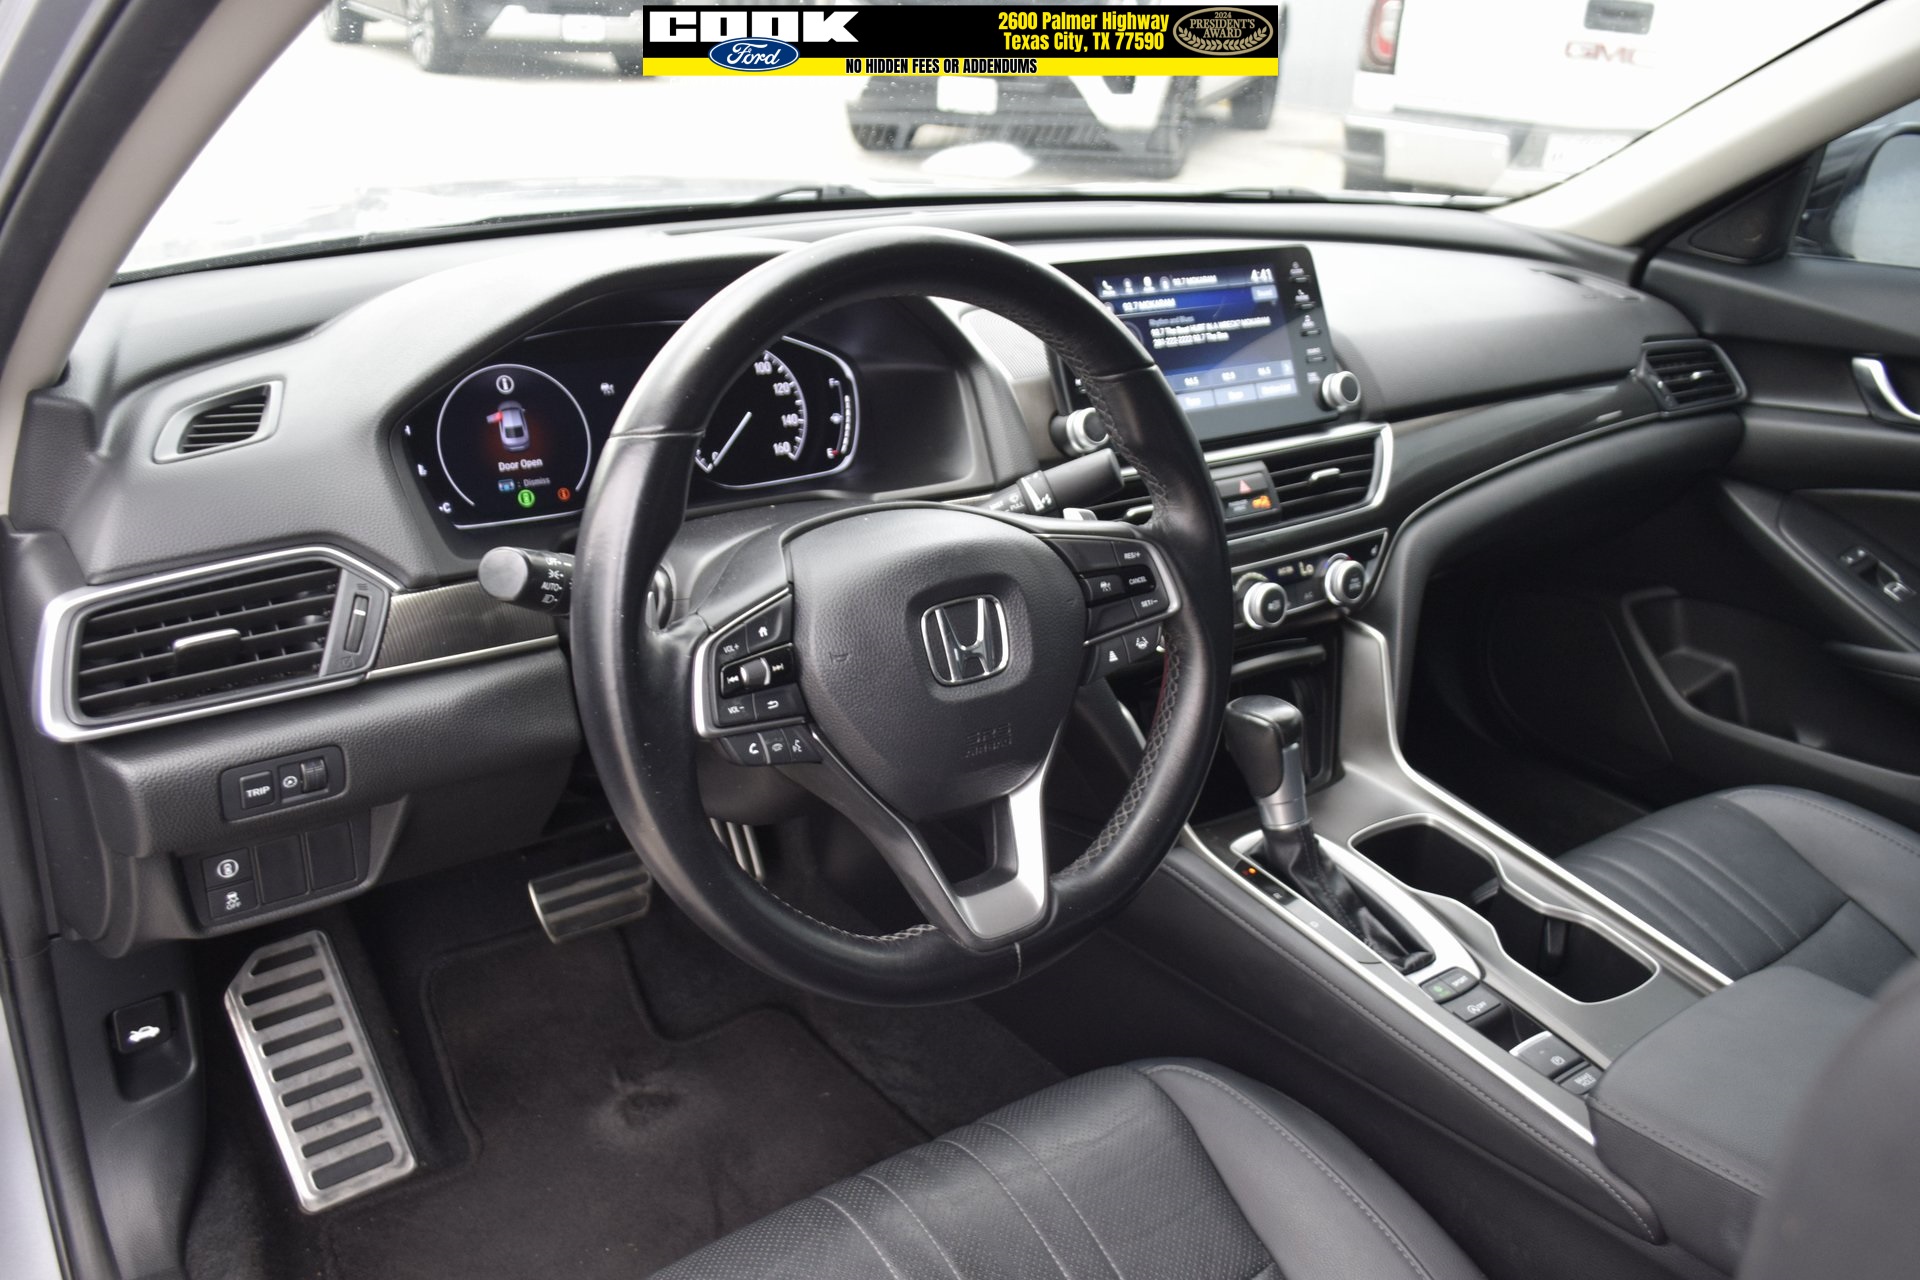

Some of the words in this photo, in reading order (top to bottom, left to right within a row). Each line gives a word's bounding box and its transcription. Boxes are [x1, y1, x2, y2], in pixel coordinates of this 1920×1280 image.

[1564, 41, 1656, 70] GMC
[1250, 268, 1275, 283] 4:41
[754, 361, 772, 374] 100
[773, 382, 791, 396] 120
[781, 413, 799, 428] 140
[773, 441, 790, 456] 160
[498, 461, 519, 472] Door
[520, 458, 544, 469] Open
[523, 476, 551, 487] Dismiss
[541, 581, 560, 592] AUTO
[1128, 575, 1148, 586] CANCEL
[246, 785, 271, 798] TRIP
[226, 900, 242, 911] OFF
